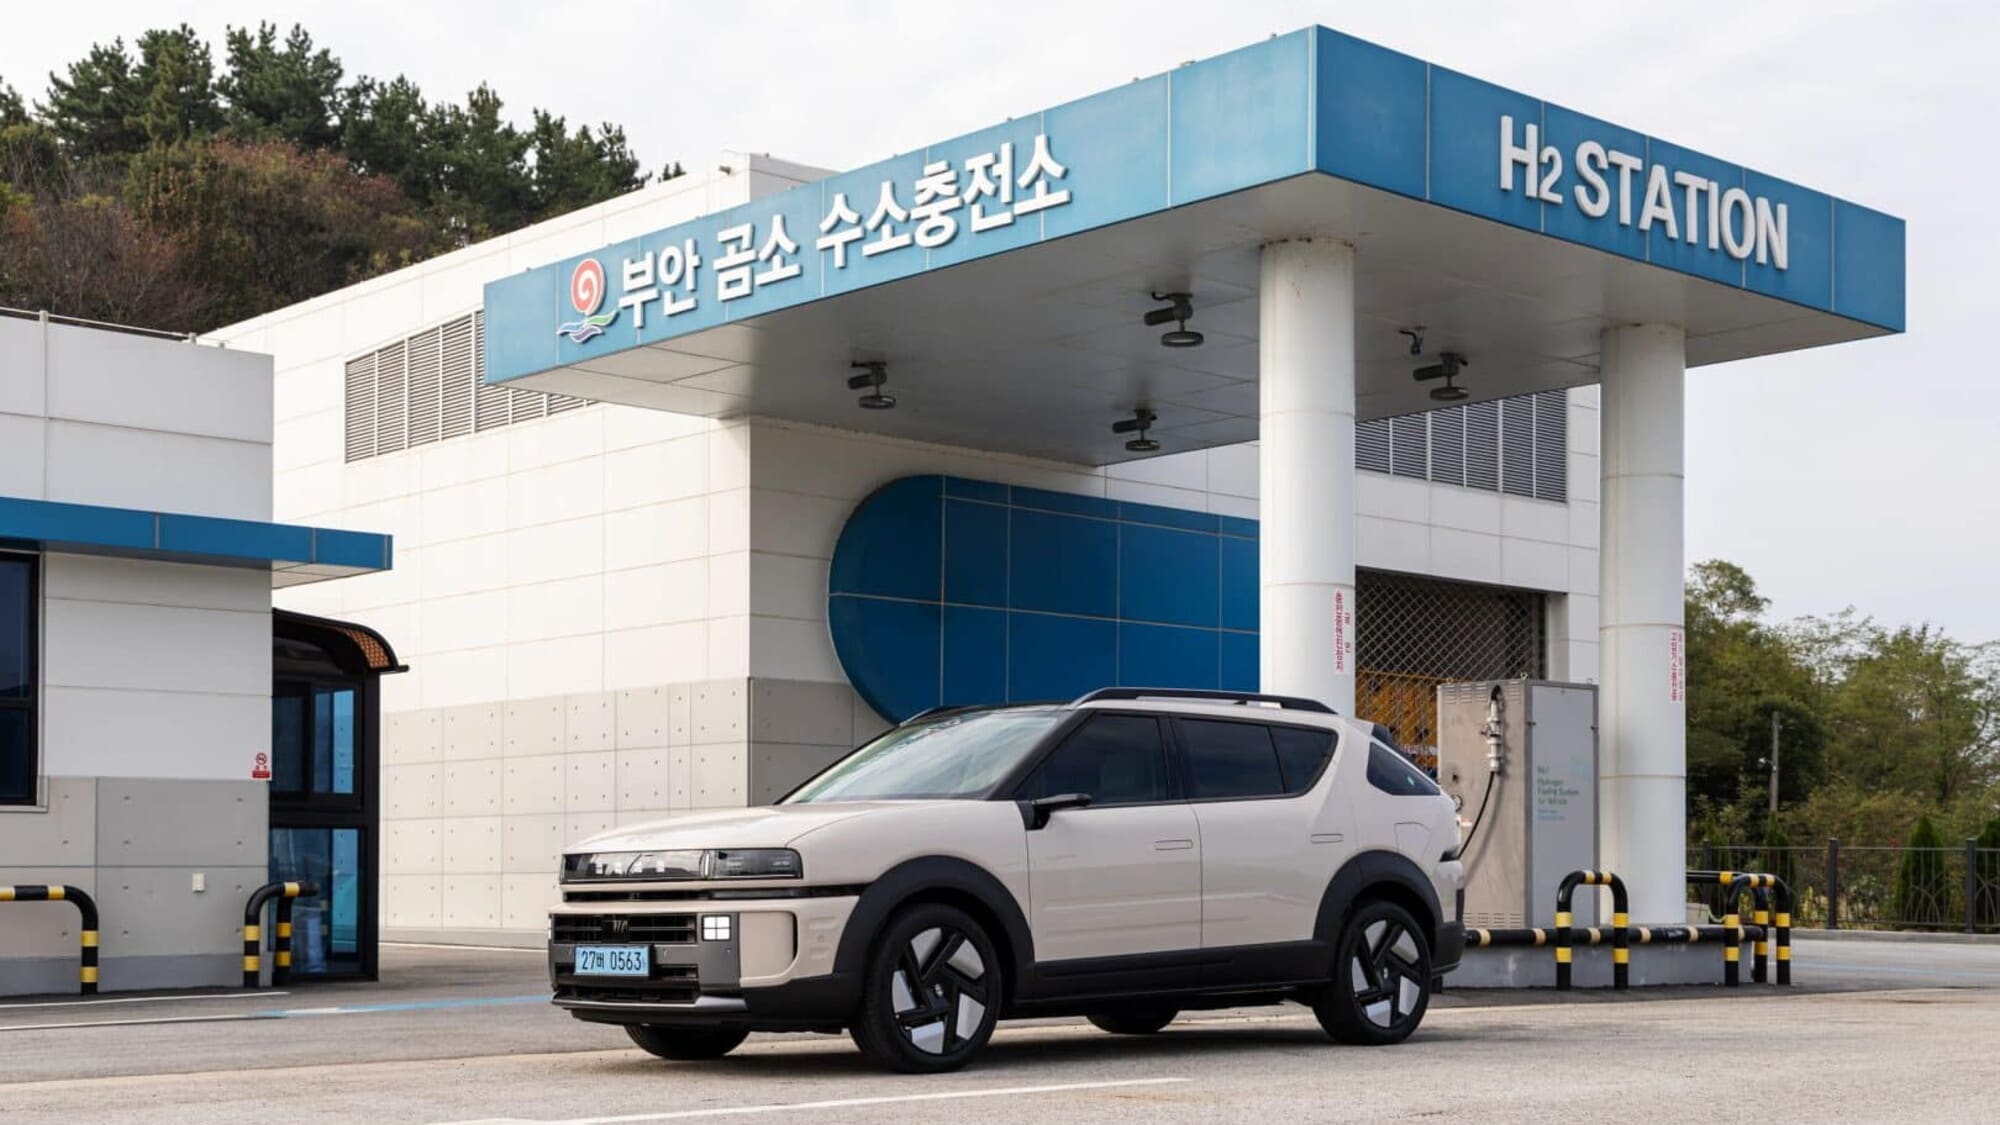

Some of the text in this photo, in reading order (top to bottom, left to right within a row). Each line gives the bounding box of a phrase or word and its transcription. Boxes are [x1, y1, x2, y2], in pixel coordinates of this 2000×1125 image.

[619, 133, 1073, 329] 부안 곰소 수소충전소
[1501, 115, 1788, 271] H2 STATION
[582, 950, 642, 971] 27버 0563
